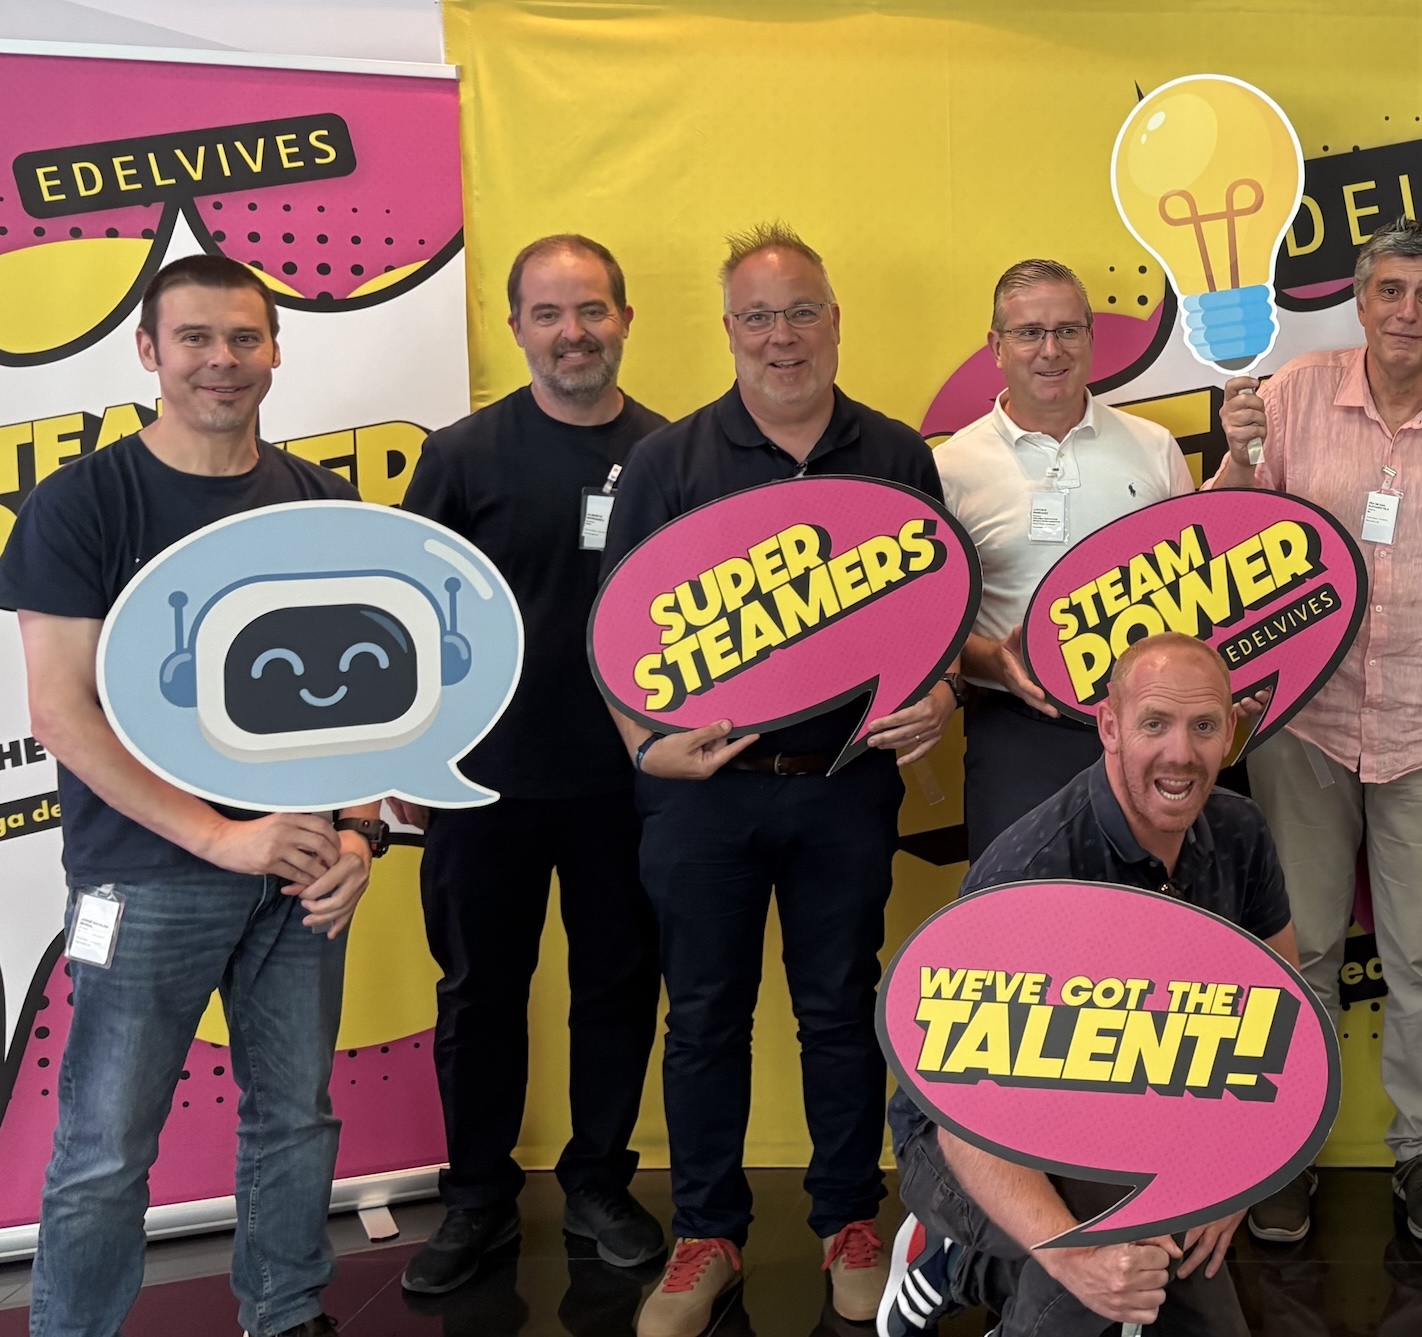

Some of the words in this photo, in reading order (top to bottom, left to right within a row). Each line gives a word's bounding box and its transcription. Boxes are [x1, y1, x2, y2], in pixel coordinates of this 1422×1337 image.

[35, 129, 339, 203] EDELVIVES
[633, 519, 940, 711] STEAMERS
[650, 523, 828, 645] SUPER
[1049, 524, 1207, 641] STEAM
[1059, 519, 1316, 703] POWER
[1225, 590, 1335, 663] EDELVIVES
[0, 736, 47, 770] HE
[915, 986, 1282, 1088] TALENT!
[919, 966, 1048, 1003] WE'VE
[1060, 975, 1150, 1010] GOT
[1167, 980, 1239, 1016] THE
